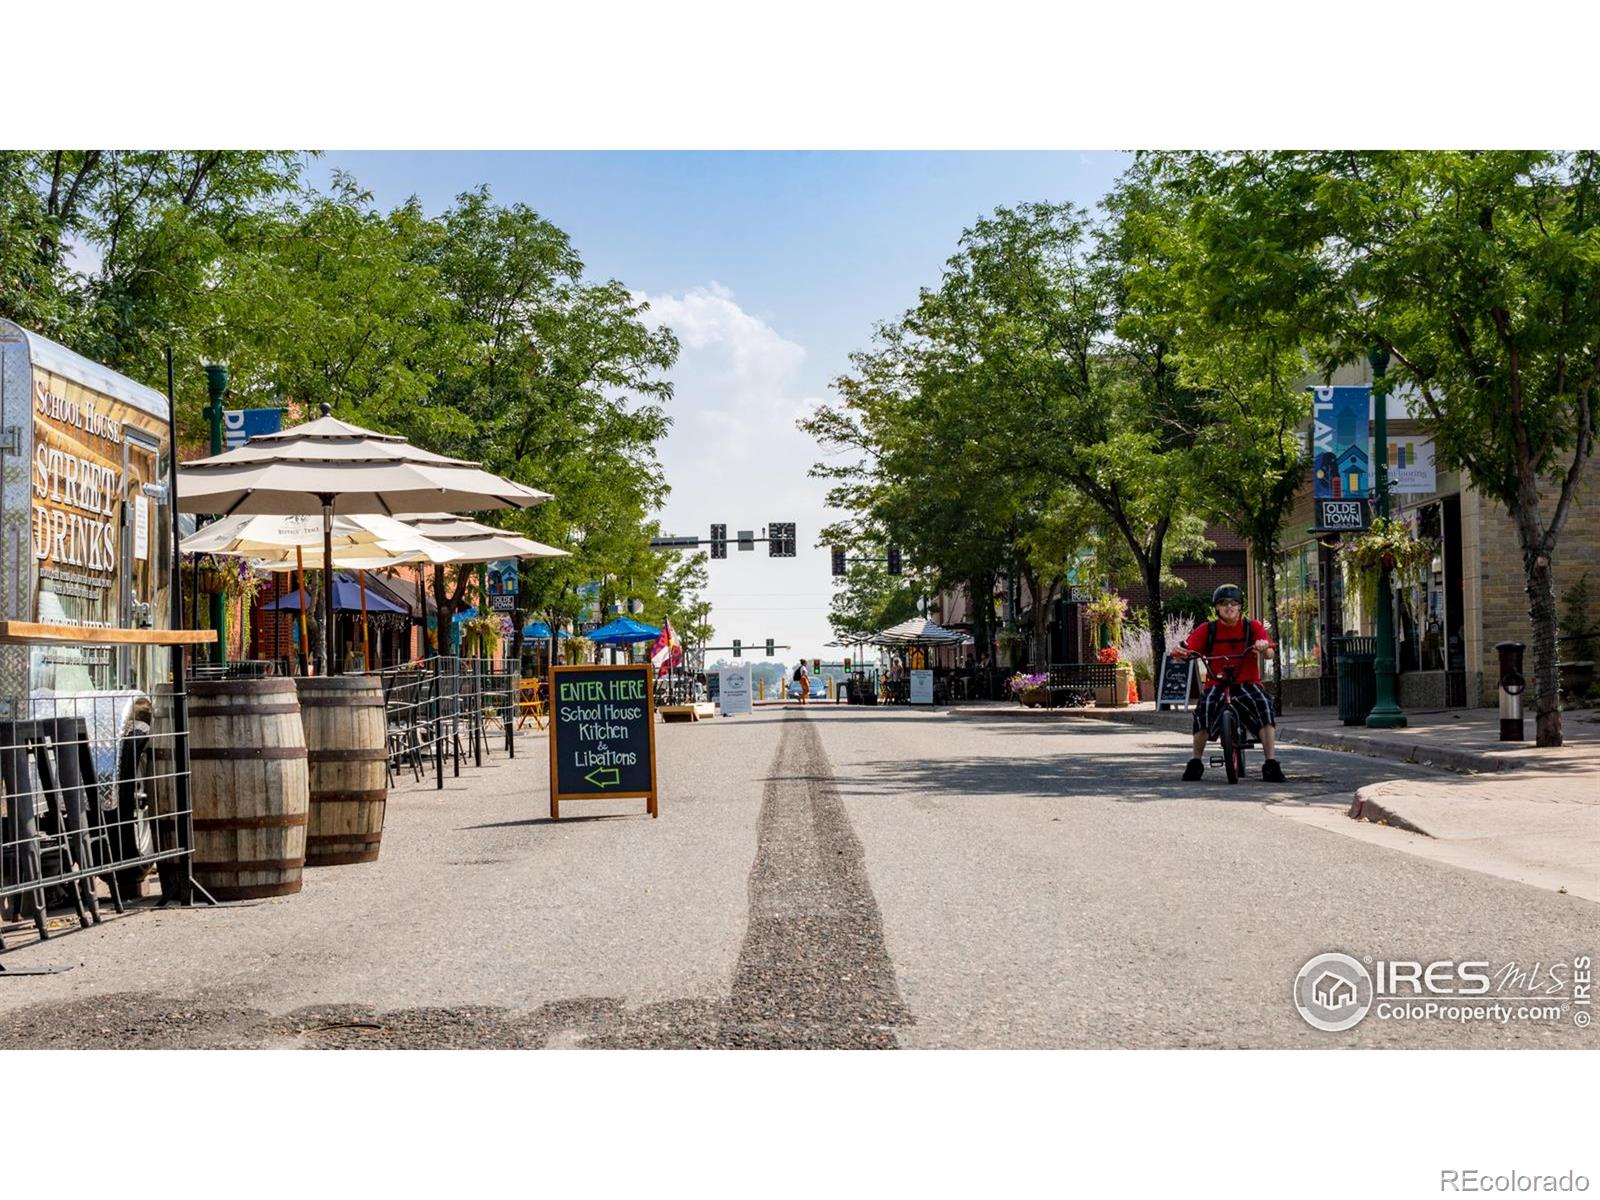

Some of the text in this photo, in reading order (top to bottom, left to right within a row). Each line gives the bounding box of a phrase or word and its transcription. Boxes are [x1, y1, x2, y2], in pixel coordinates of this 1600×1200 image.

[1313, 385, 1334, 452] PLAY
[36, 443, 116, 518] STREET
[1326, 503, 1358, 514] OLDE
[1325, 513, 1360, 524] TOWN
[34, 505, 115, 573] DRINKS
[560, 680, 646, 701] ENTER HERE
[560, 704, 642, 722] School House
[579, 722, 629, 741] Kitchen
[597, 741, 608, 751] &
[574, 750, 637, 767] Libations
